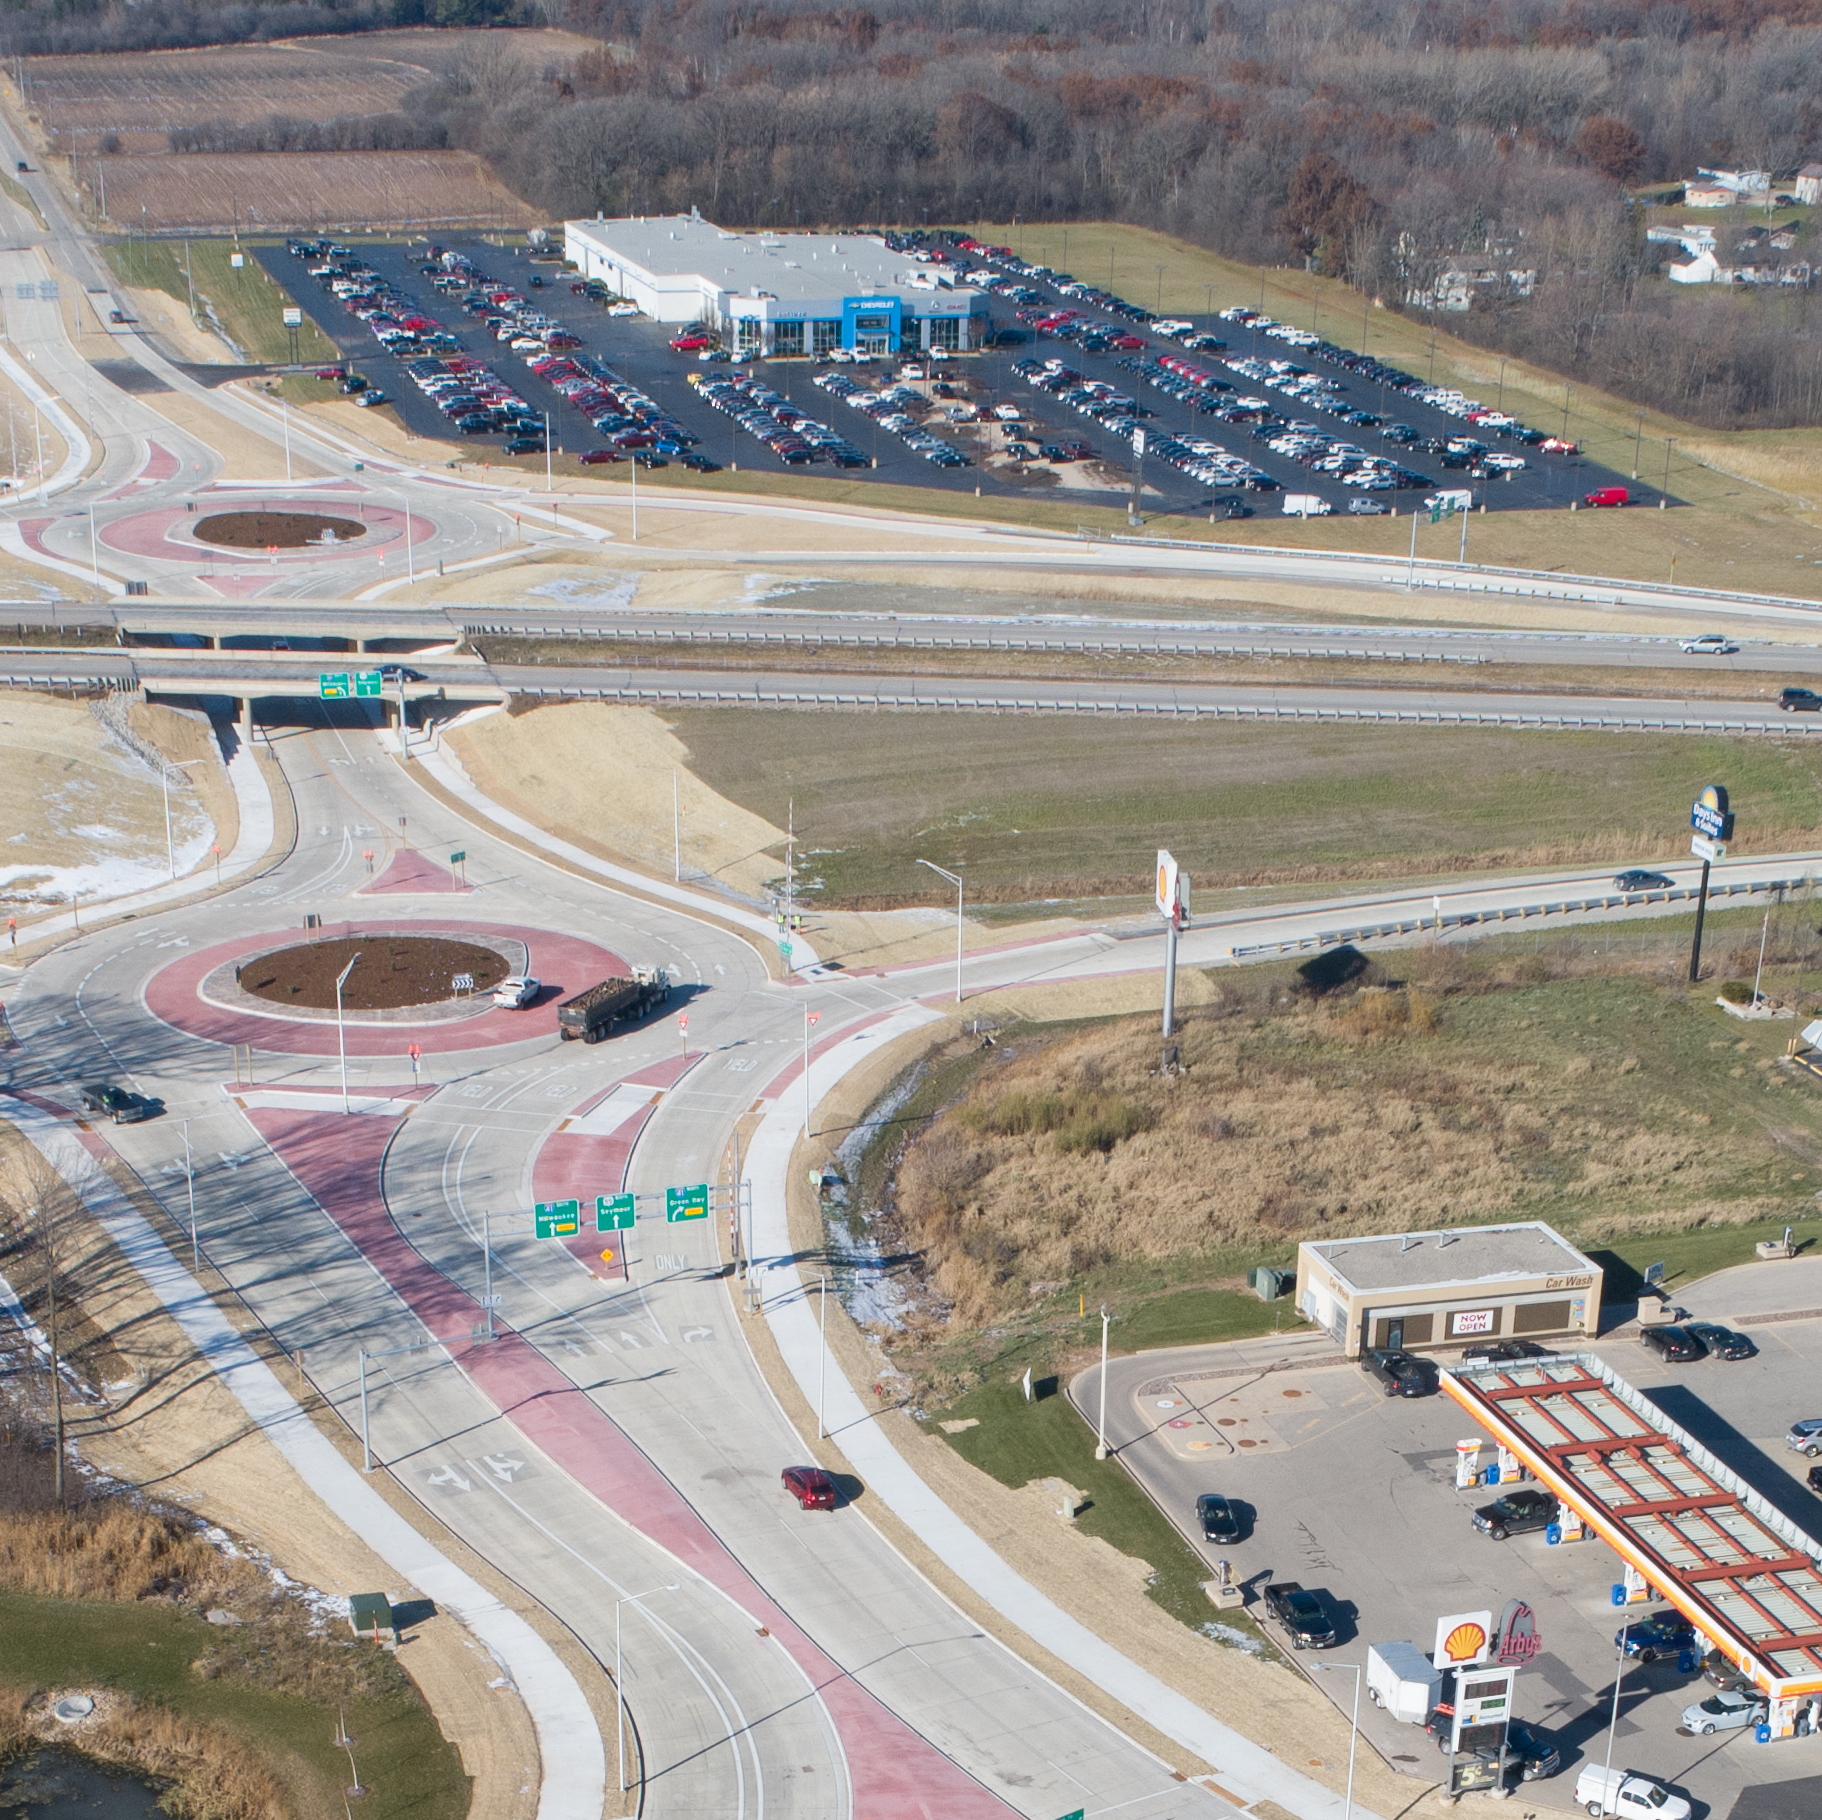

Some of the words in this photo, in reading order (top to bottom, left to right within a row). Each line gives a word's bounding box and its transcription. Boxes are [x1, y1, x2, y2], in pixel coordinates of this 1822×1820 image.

[1710, 811, 1723, 827] Inn
[600, 1206, 631, 1215] Seymour
[655, 1254, 686, 1270] ONLY
[1545, 1277, 1563, 1289] Car
[1565, 1274, 1593, 1287] Wash
[1336, 1283, 1350, 1302] Wash
[1460, 1313, 1486, 1322] NOW
[1459, 1322, 1486, 1331] OPEN
[1499, 1630, 1542, 1657] Arby's
